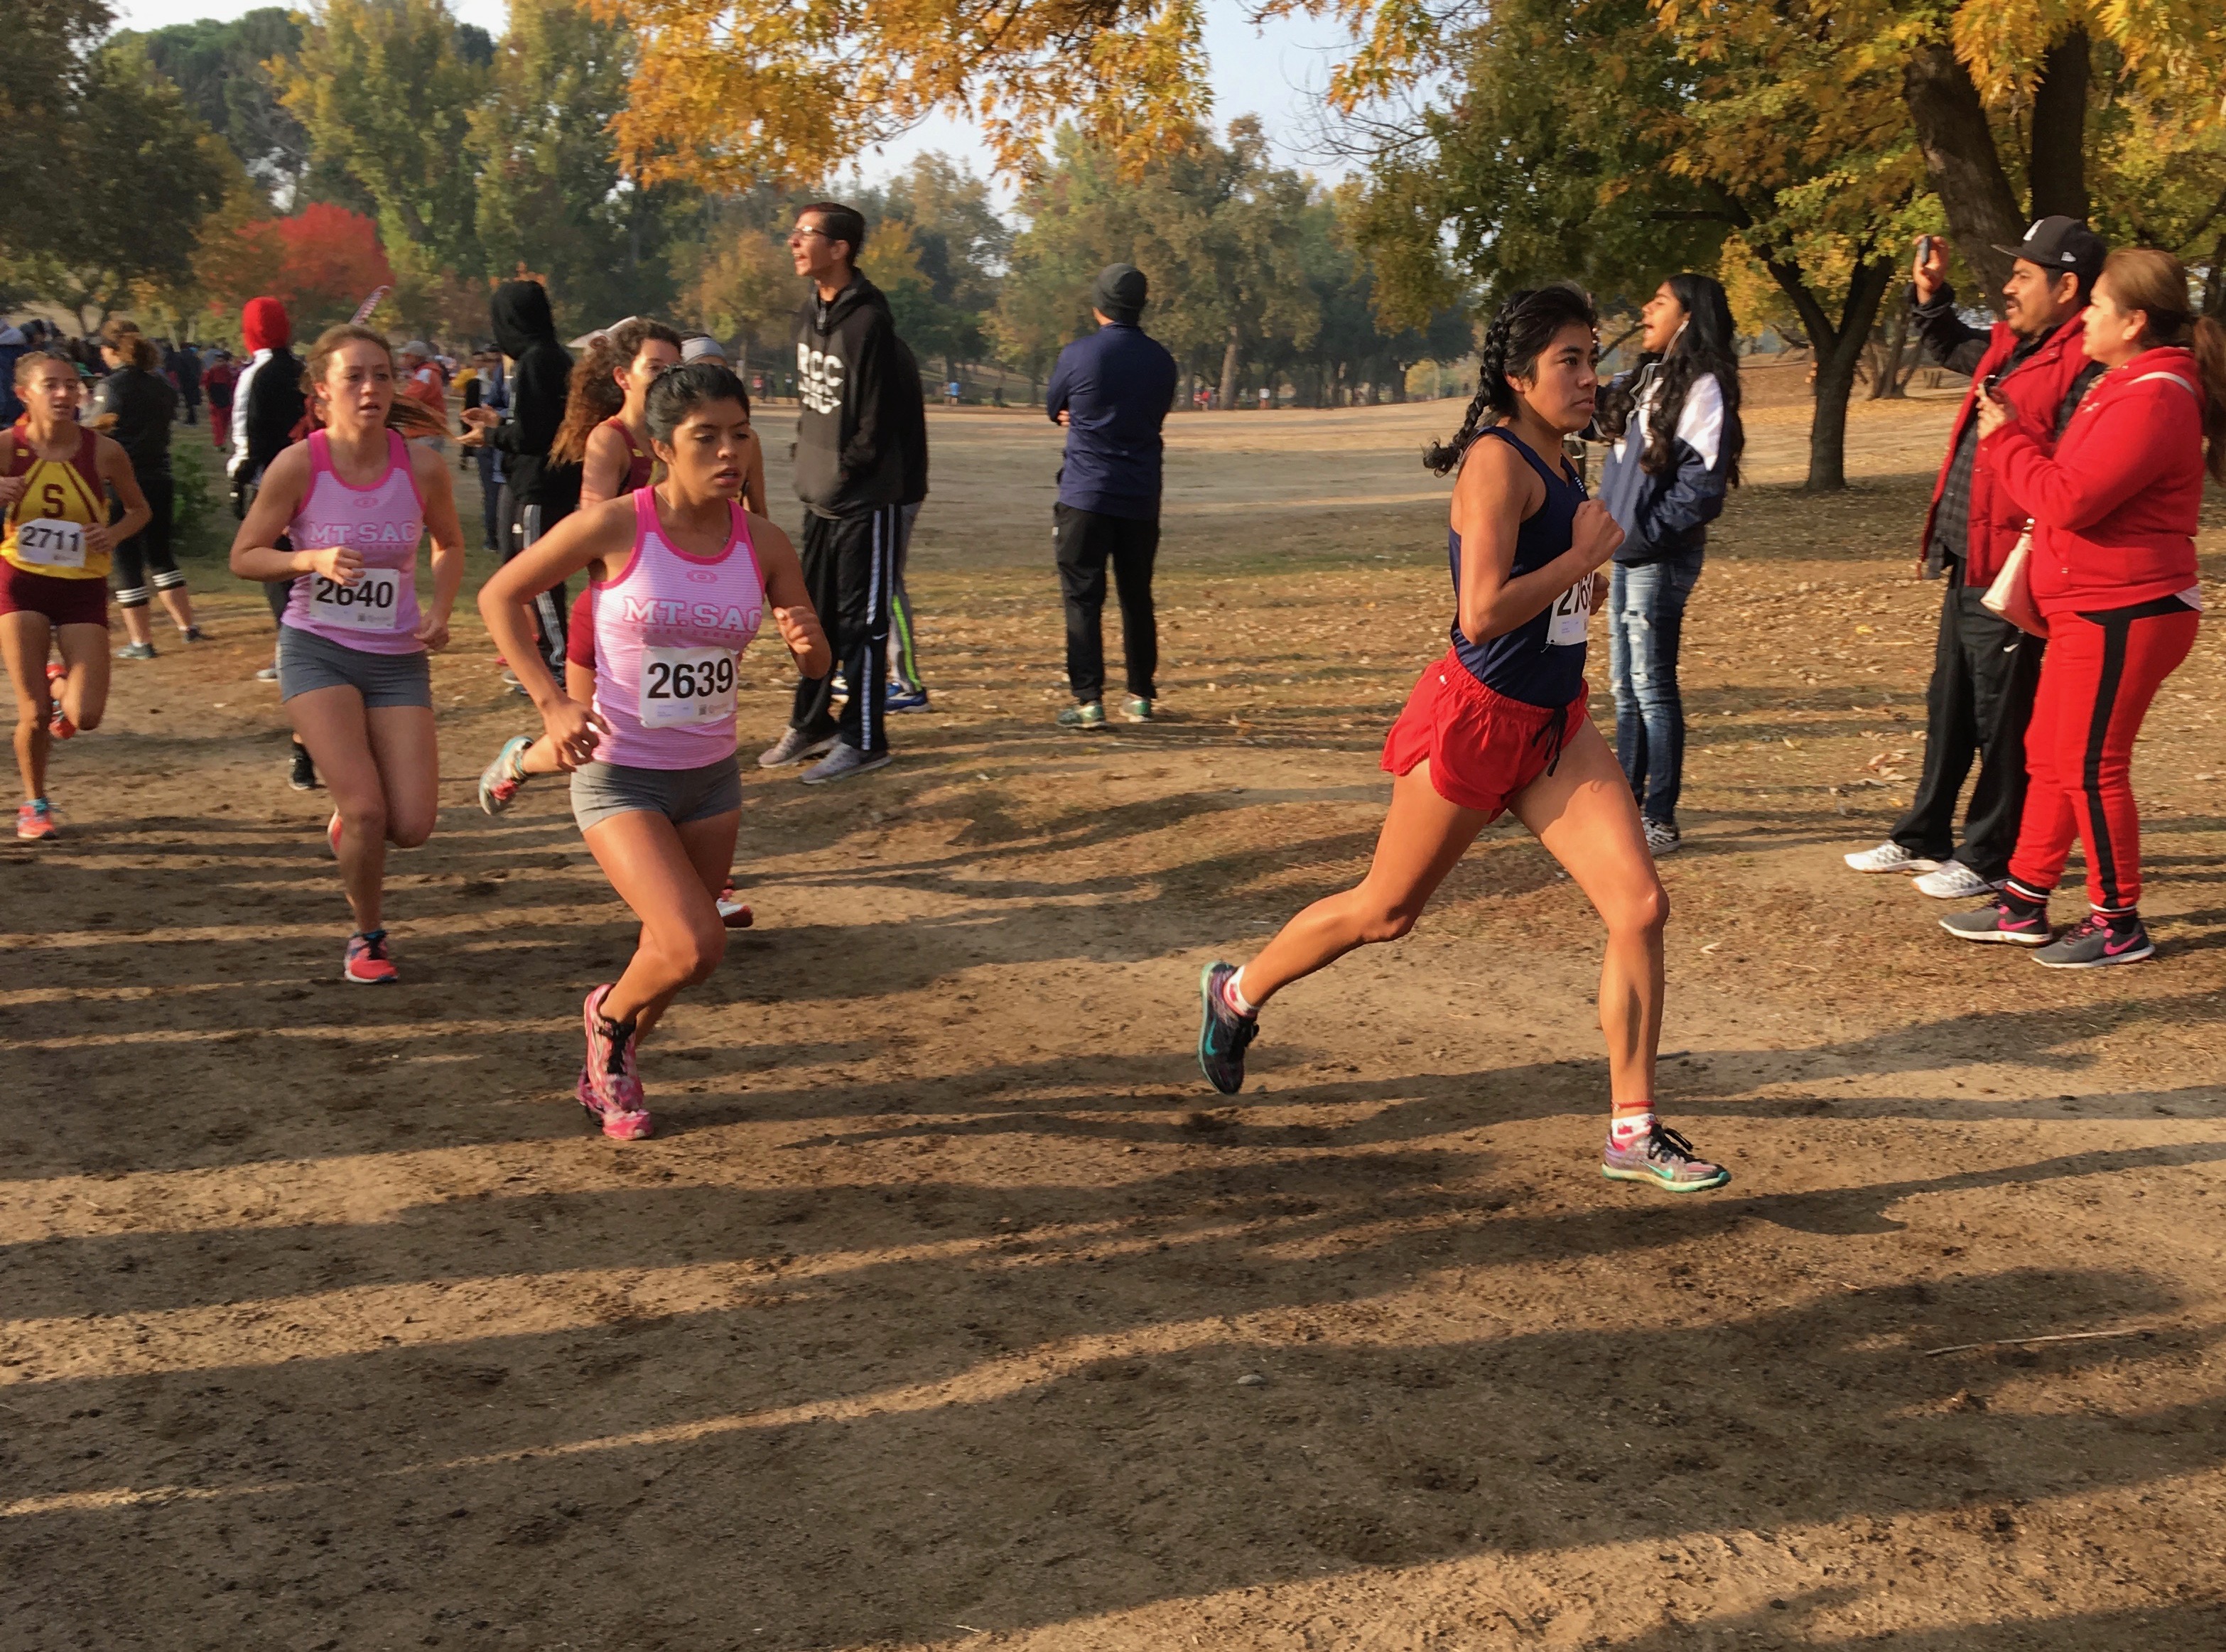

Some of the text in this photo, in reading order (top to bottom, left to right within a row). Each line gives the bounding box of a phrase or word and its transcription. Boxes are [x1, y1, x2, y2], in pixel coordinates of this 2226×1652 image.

[42, 483, 65, 518] S
[21, 526, 80, 552] 2711
[358, 520, 416, 544] SAC
[315, 576, 394, 608] 2640
[622, 598, 688, 625] MT.
[647, 657, 733, 699] 2639
